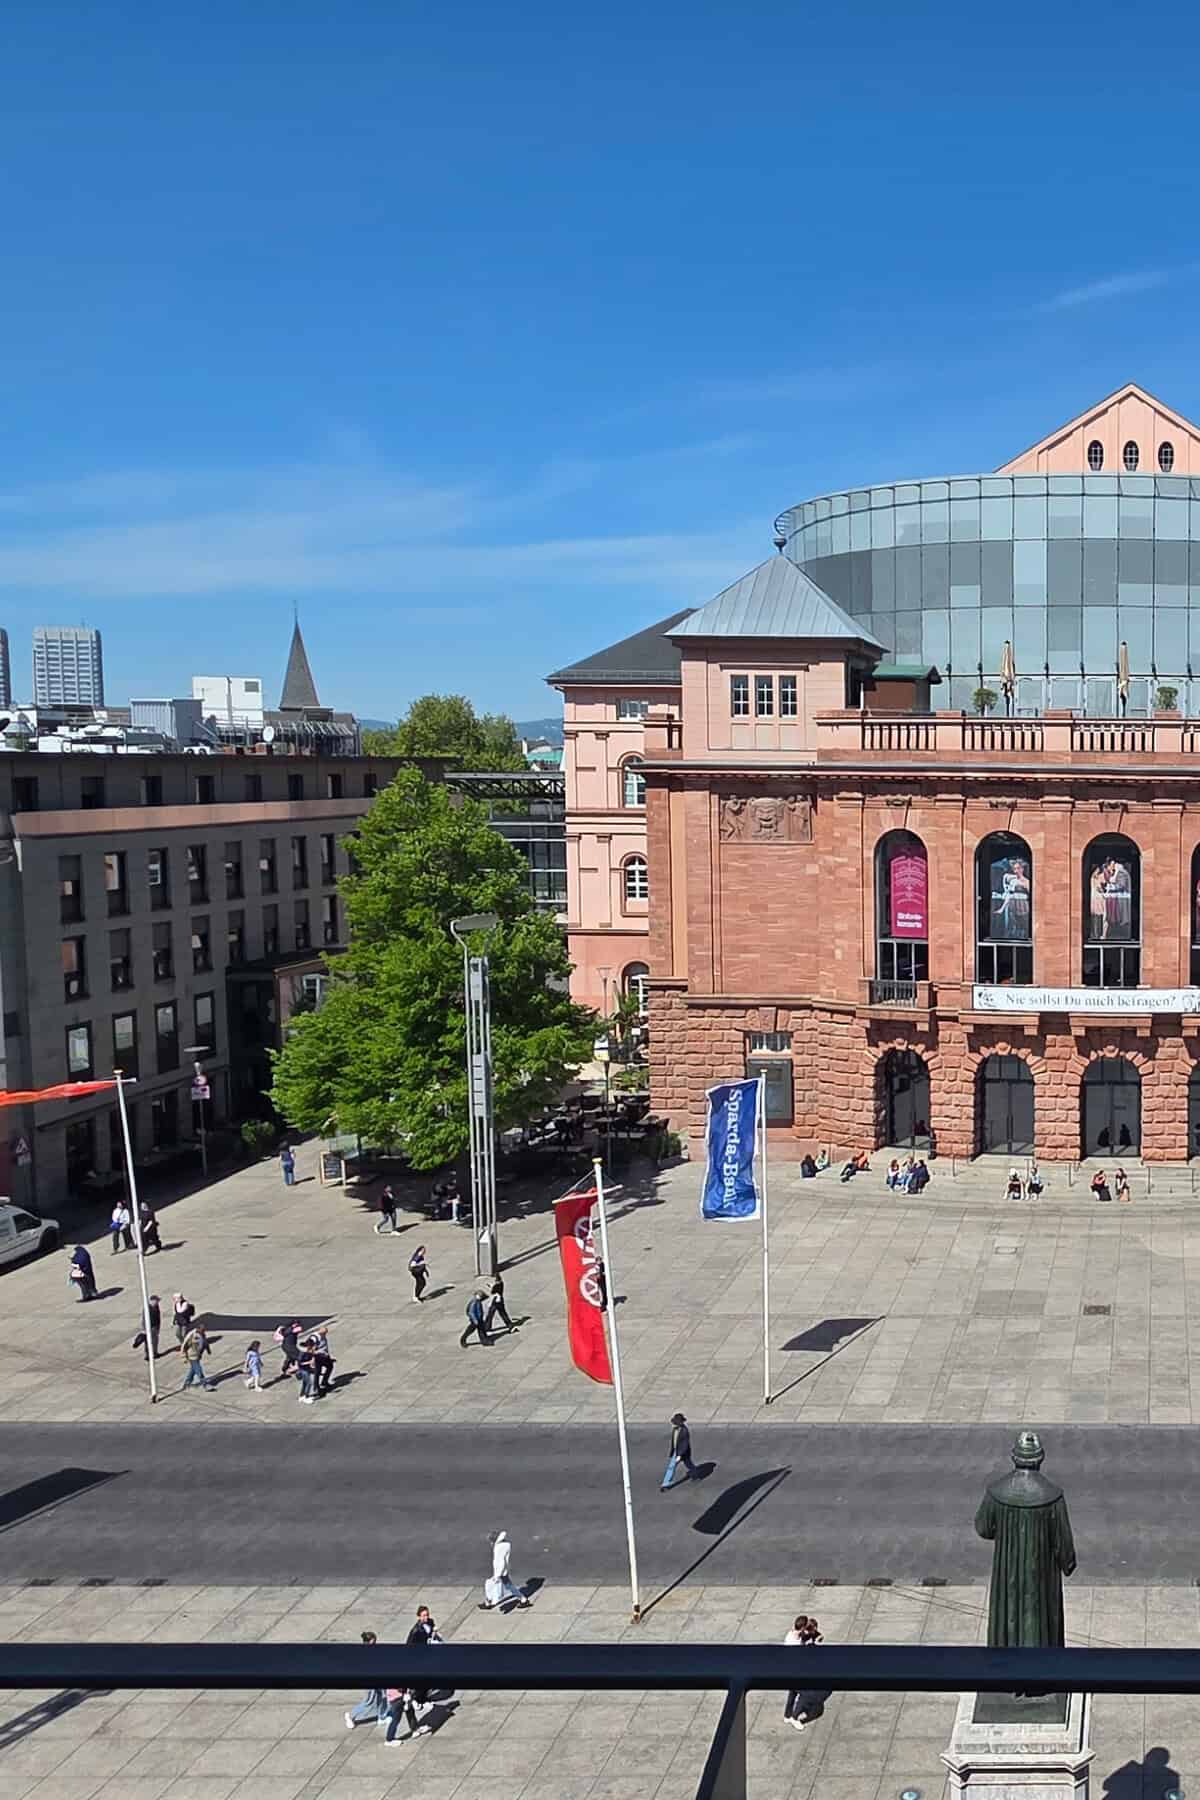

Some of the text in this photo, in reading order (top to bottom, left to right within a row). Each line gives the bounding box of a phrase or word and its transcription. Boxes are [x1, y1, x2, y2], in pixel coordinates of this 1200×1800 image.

[1005, 993, 1026, 1006] Nie
[1028, 993, 1060, 1006] sollst
[1064, 994, 1082, 1006] Du
[1085, 994, 1114, 1007] mich
[723, 1089, 743, 1208] Sparda-Bank
